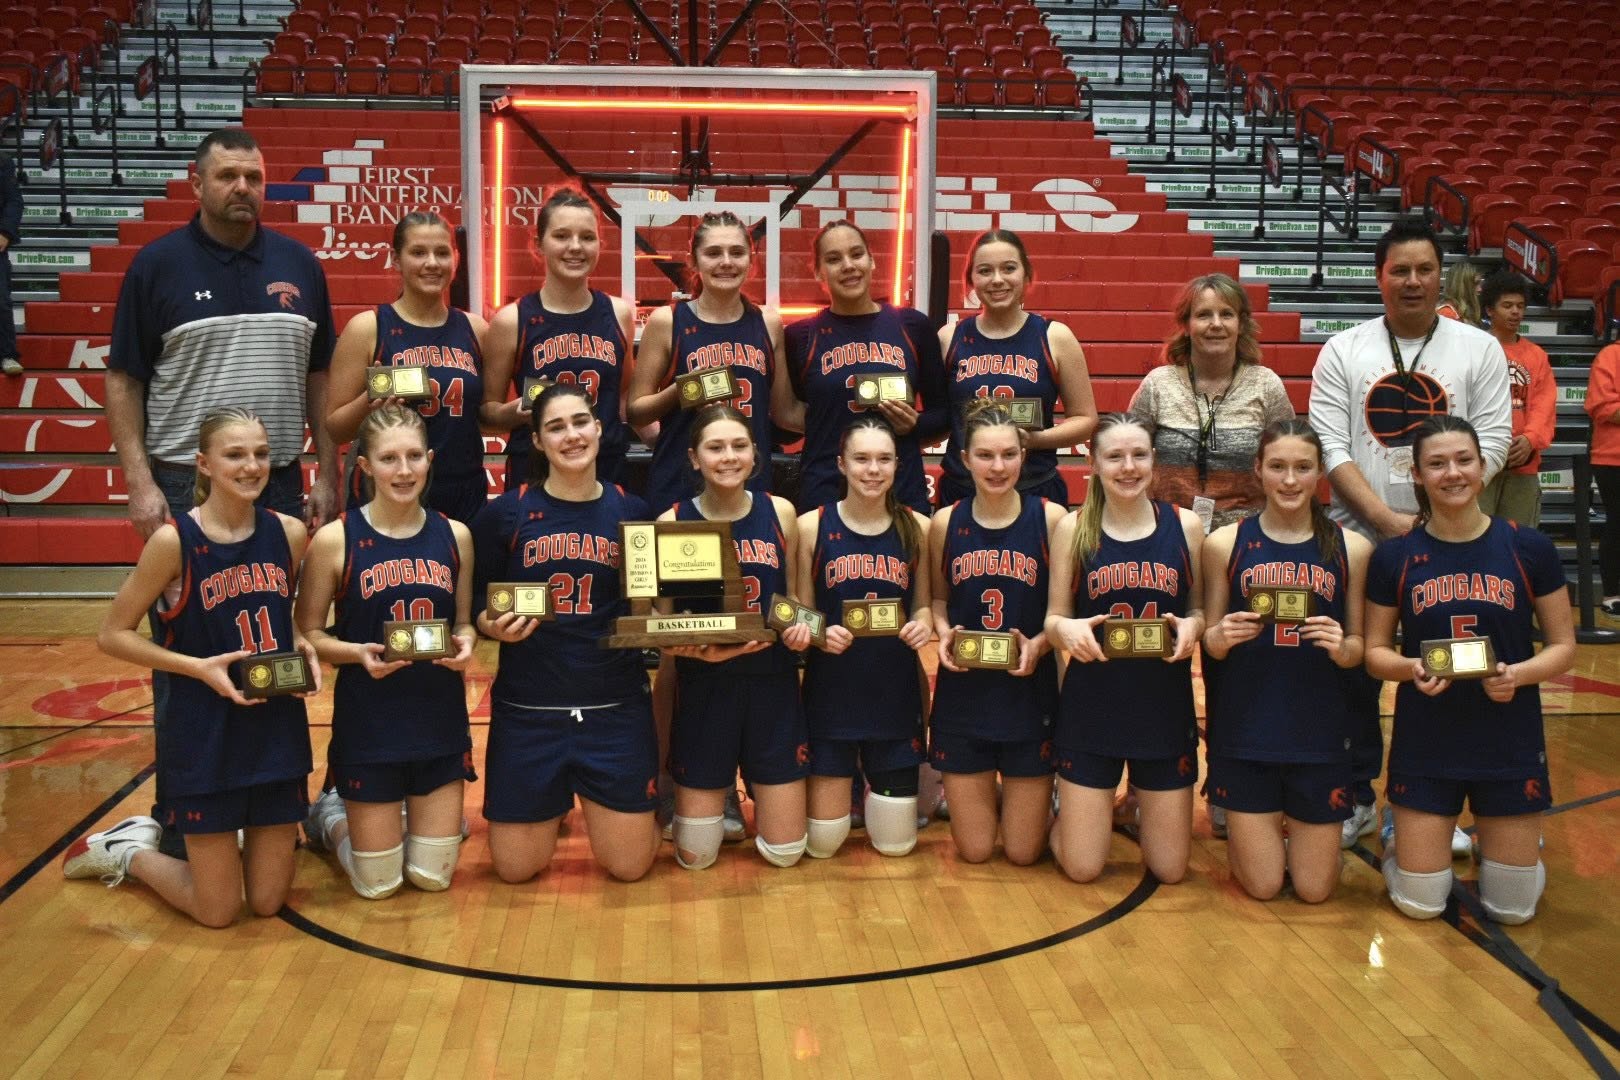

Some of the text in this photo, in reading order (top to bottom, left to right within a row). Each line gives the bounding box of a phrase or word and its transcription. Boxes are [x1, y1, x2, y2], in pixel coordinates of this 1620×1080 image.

[365, 168, 434, 184] FIRST
[392, 345, 478, 376] COUGARS
[532, 333, 617, 370] COUGARS
[686, 341, 767, 376] COUGARS
[821, 341, 906, 375] COUGARS
[956, 354, 1039, 384] COUGARS
[523, 532, 621, 569] COUGARS
[951, 549, 1038, 587] COUGARS
[200, 562, 289, 611] COUGARS
[361, 558, 454, 600] COUGARS
[825, 553, 909, 590] COUGARS
[1087, 561, 1179, 600] COUGARS
[1240, 561, 1336, 602] COUGARS
[549, 572, 594, 615] 21
[981, 588, 1004, 631] 3
[1411, 573, 1515, 615] COUGARS
[235, 605, 278, 655] 11
[657, 618, 727, 631] BASKETBALL
